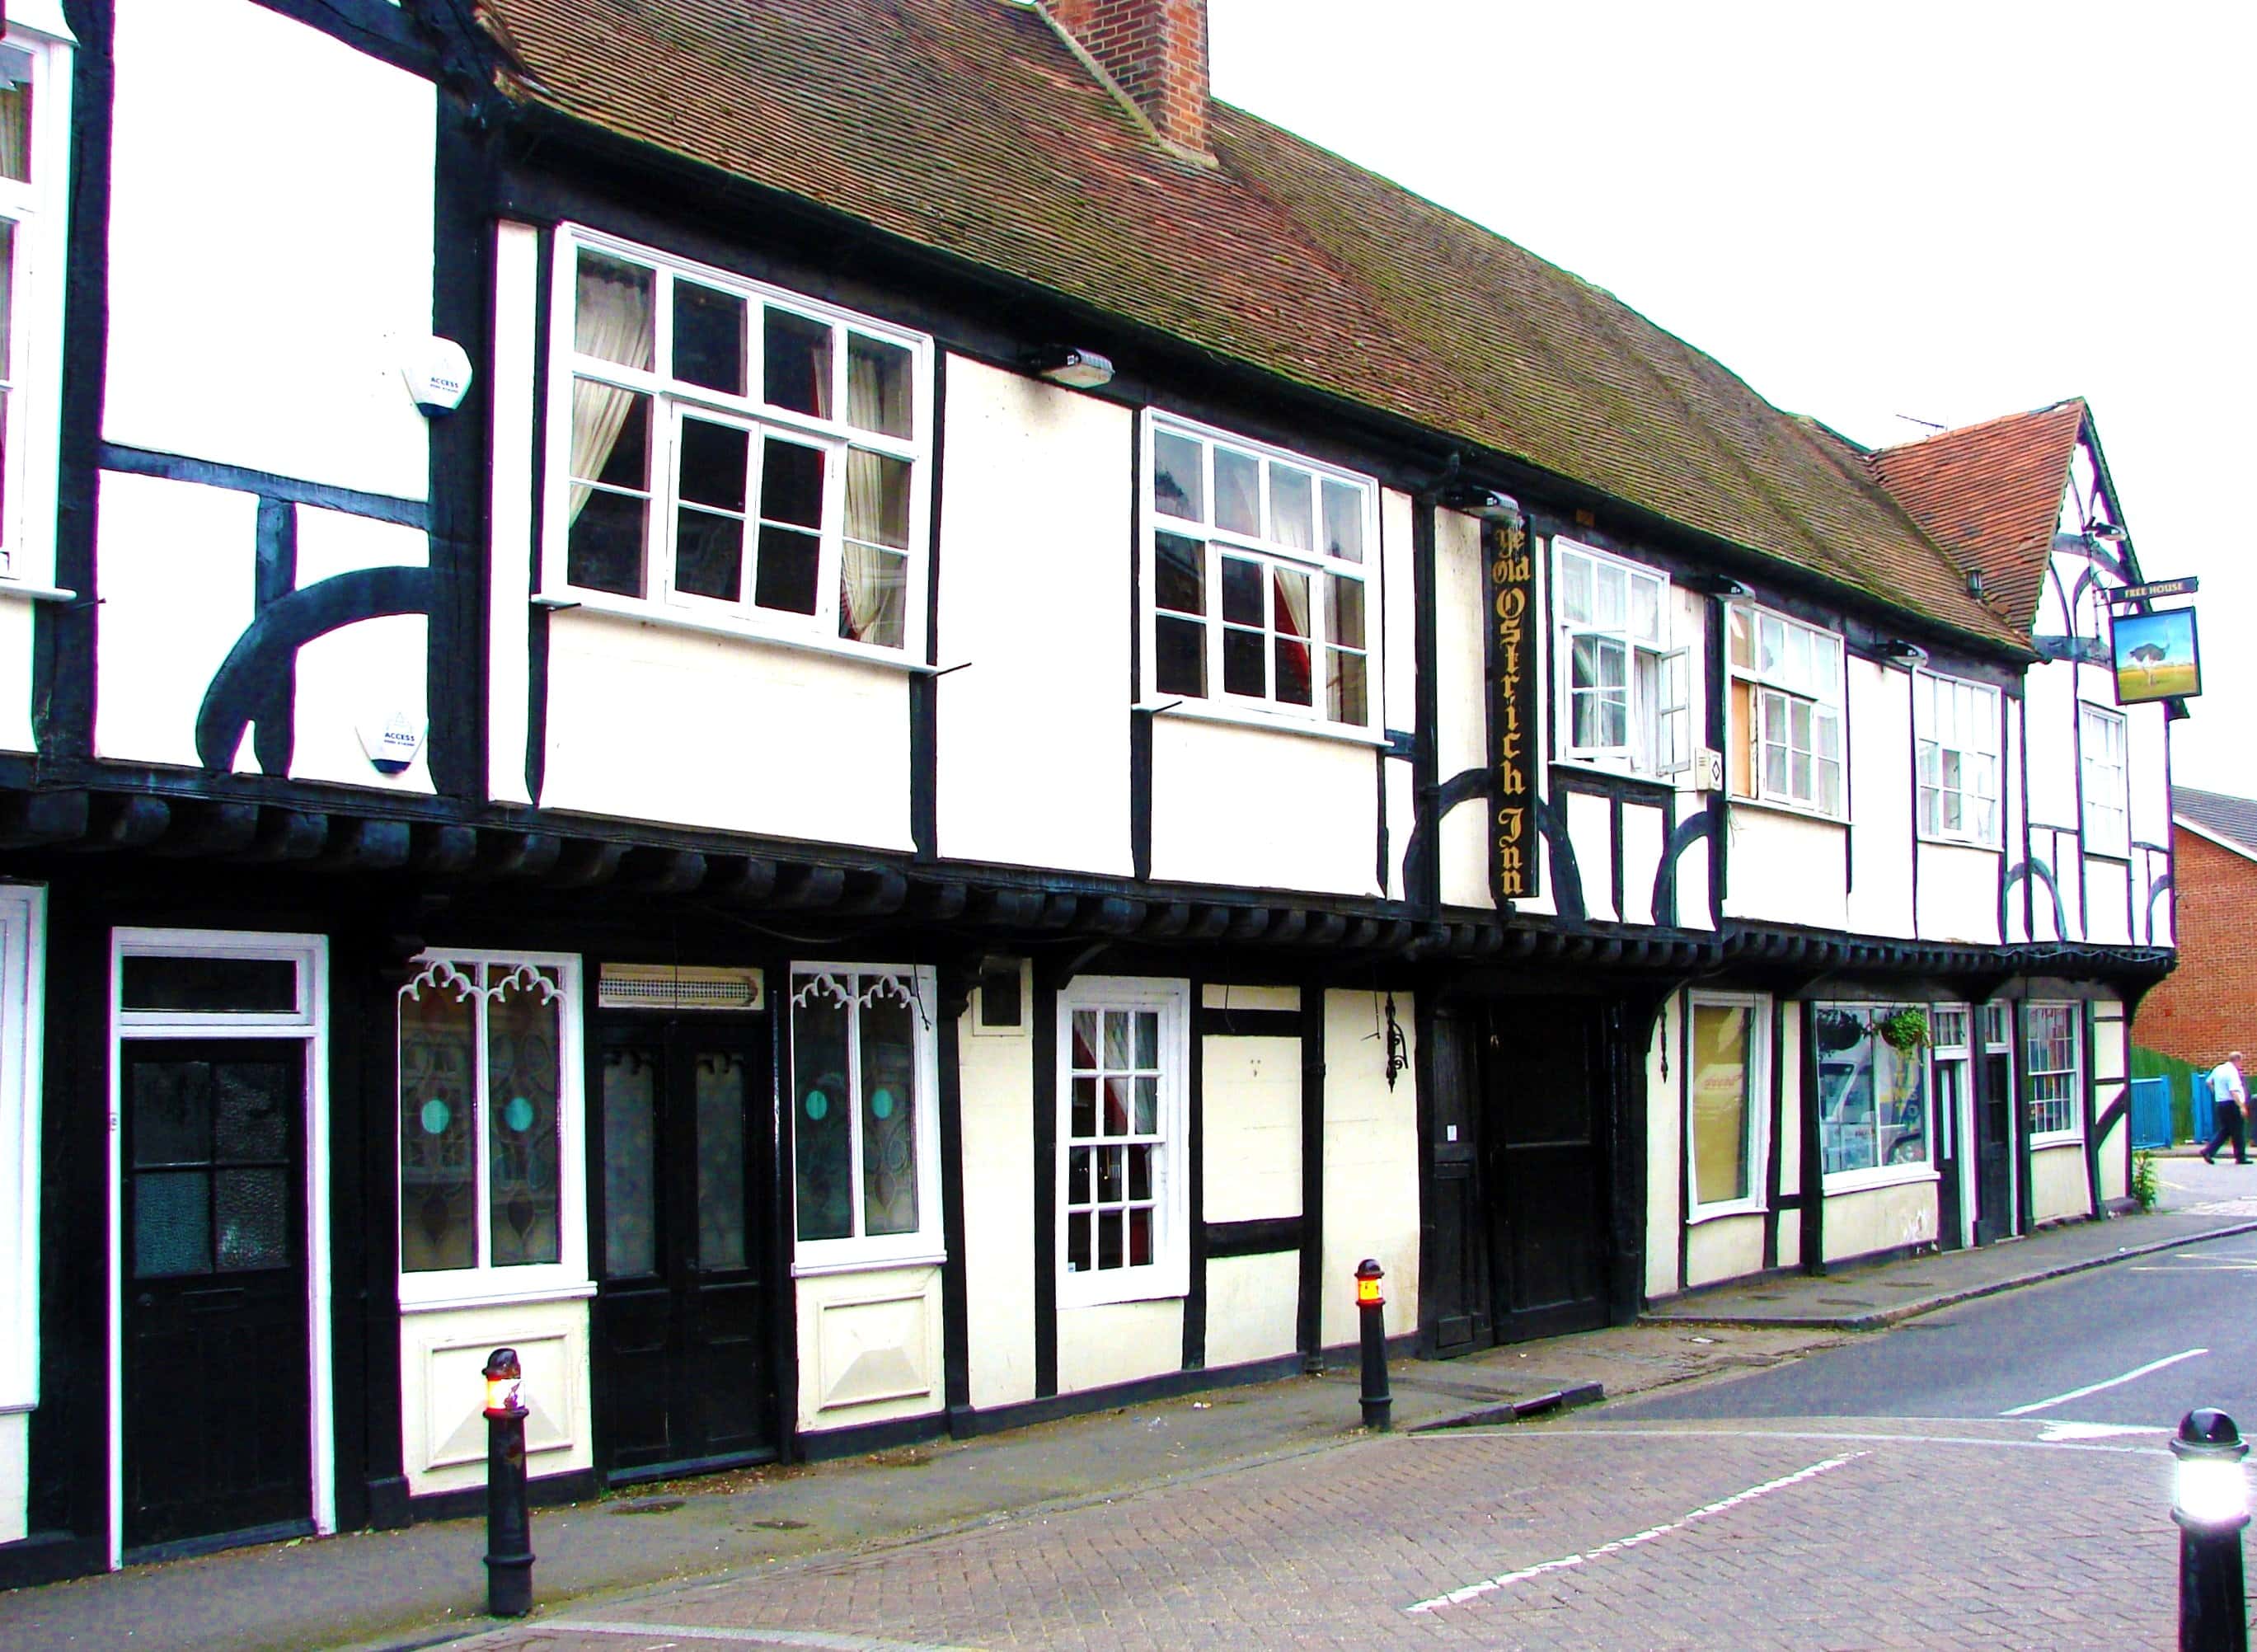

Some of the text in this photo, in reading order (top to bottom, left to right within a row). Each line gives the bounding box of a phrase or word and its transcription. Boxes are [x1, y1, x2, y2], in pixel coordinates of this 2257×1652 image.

[1492, 555, 1531, 584] Old
[2124, 581, 2184, 598] FREE HOUSE
[384, 732, 415, 741] ACCESS
[1498, 807, 1524, 895] Inn
